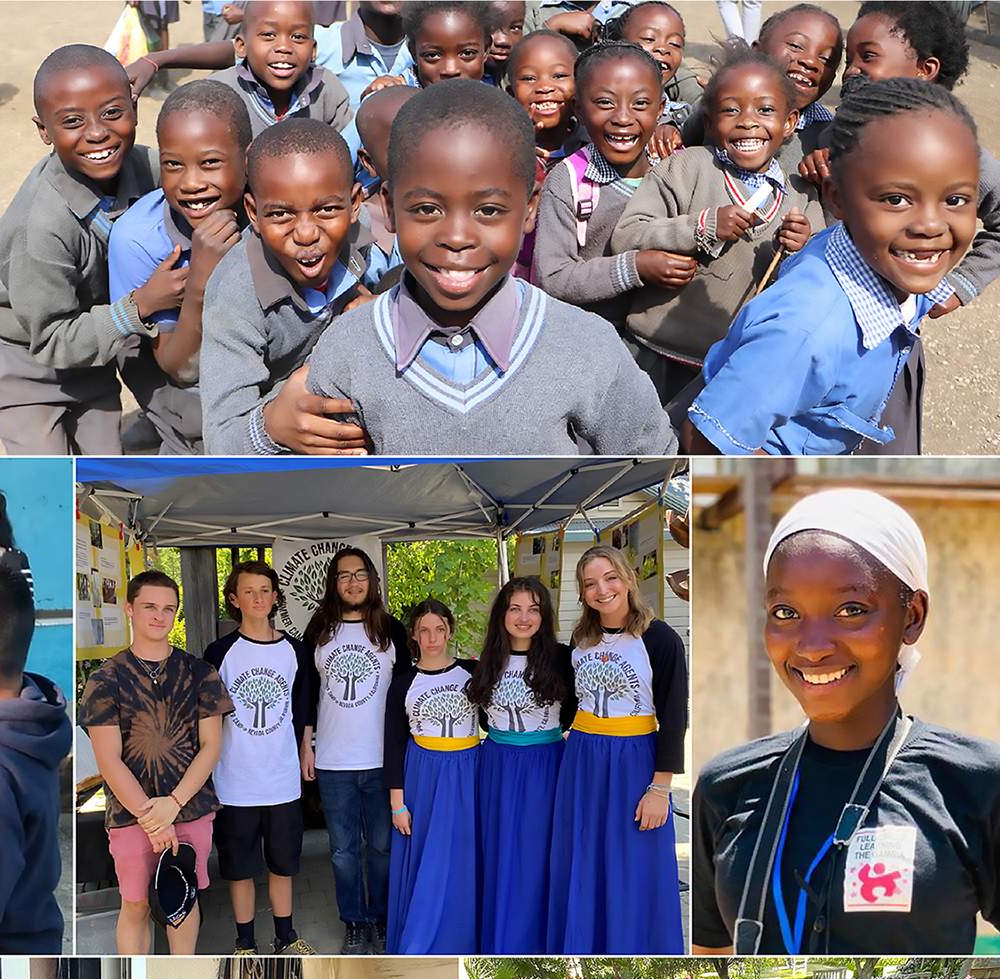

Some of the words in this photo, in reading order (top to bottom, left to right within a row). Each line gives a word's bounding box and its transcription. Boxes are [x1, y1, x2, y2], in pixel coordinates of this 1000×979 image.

[279, 549, 311, 587] CLIMATE
[324, 646, 341, 670] CLIMATE
[342, 644, 366, 653] CHANGE
[364, 649, 381, 671] AGENTS
[229, 670, 251, 694] CLIMATE
[251, 667, 277, 678] CHANGE
[275, 674, 290, 697] AGENTS
[619, 660, 640, 689] AGENTS
[413, 691, 431, 717] CLIMATE
[430, 684, 459, 695] CHANGE
